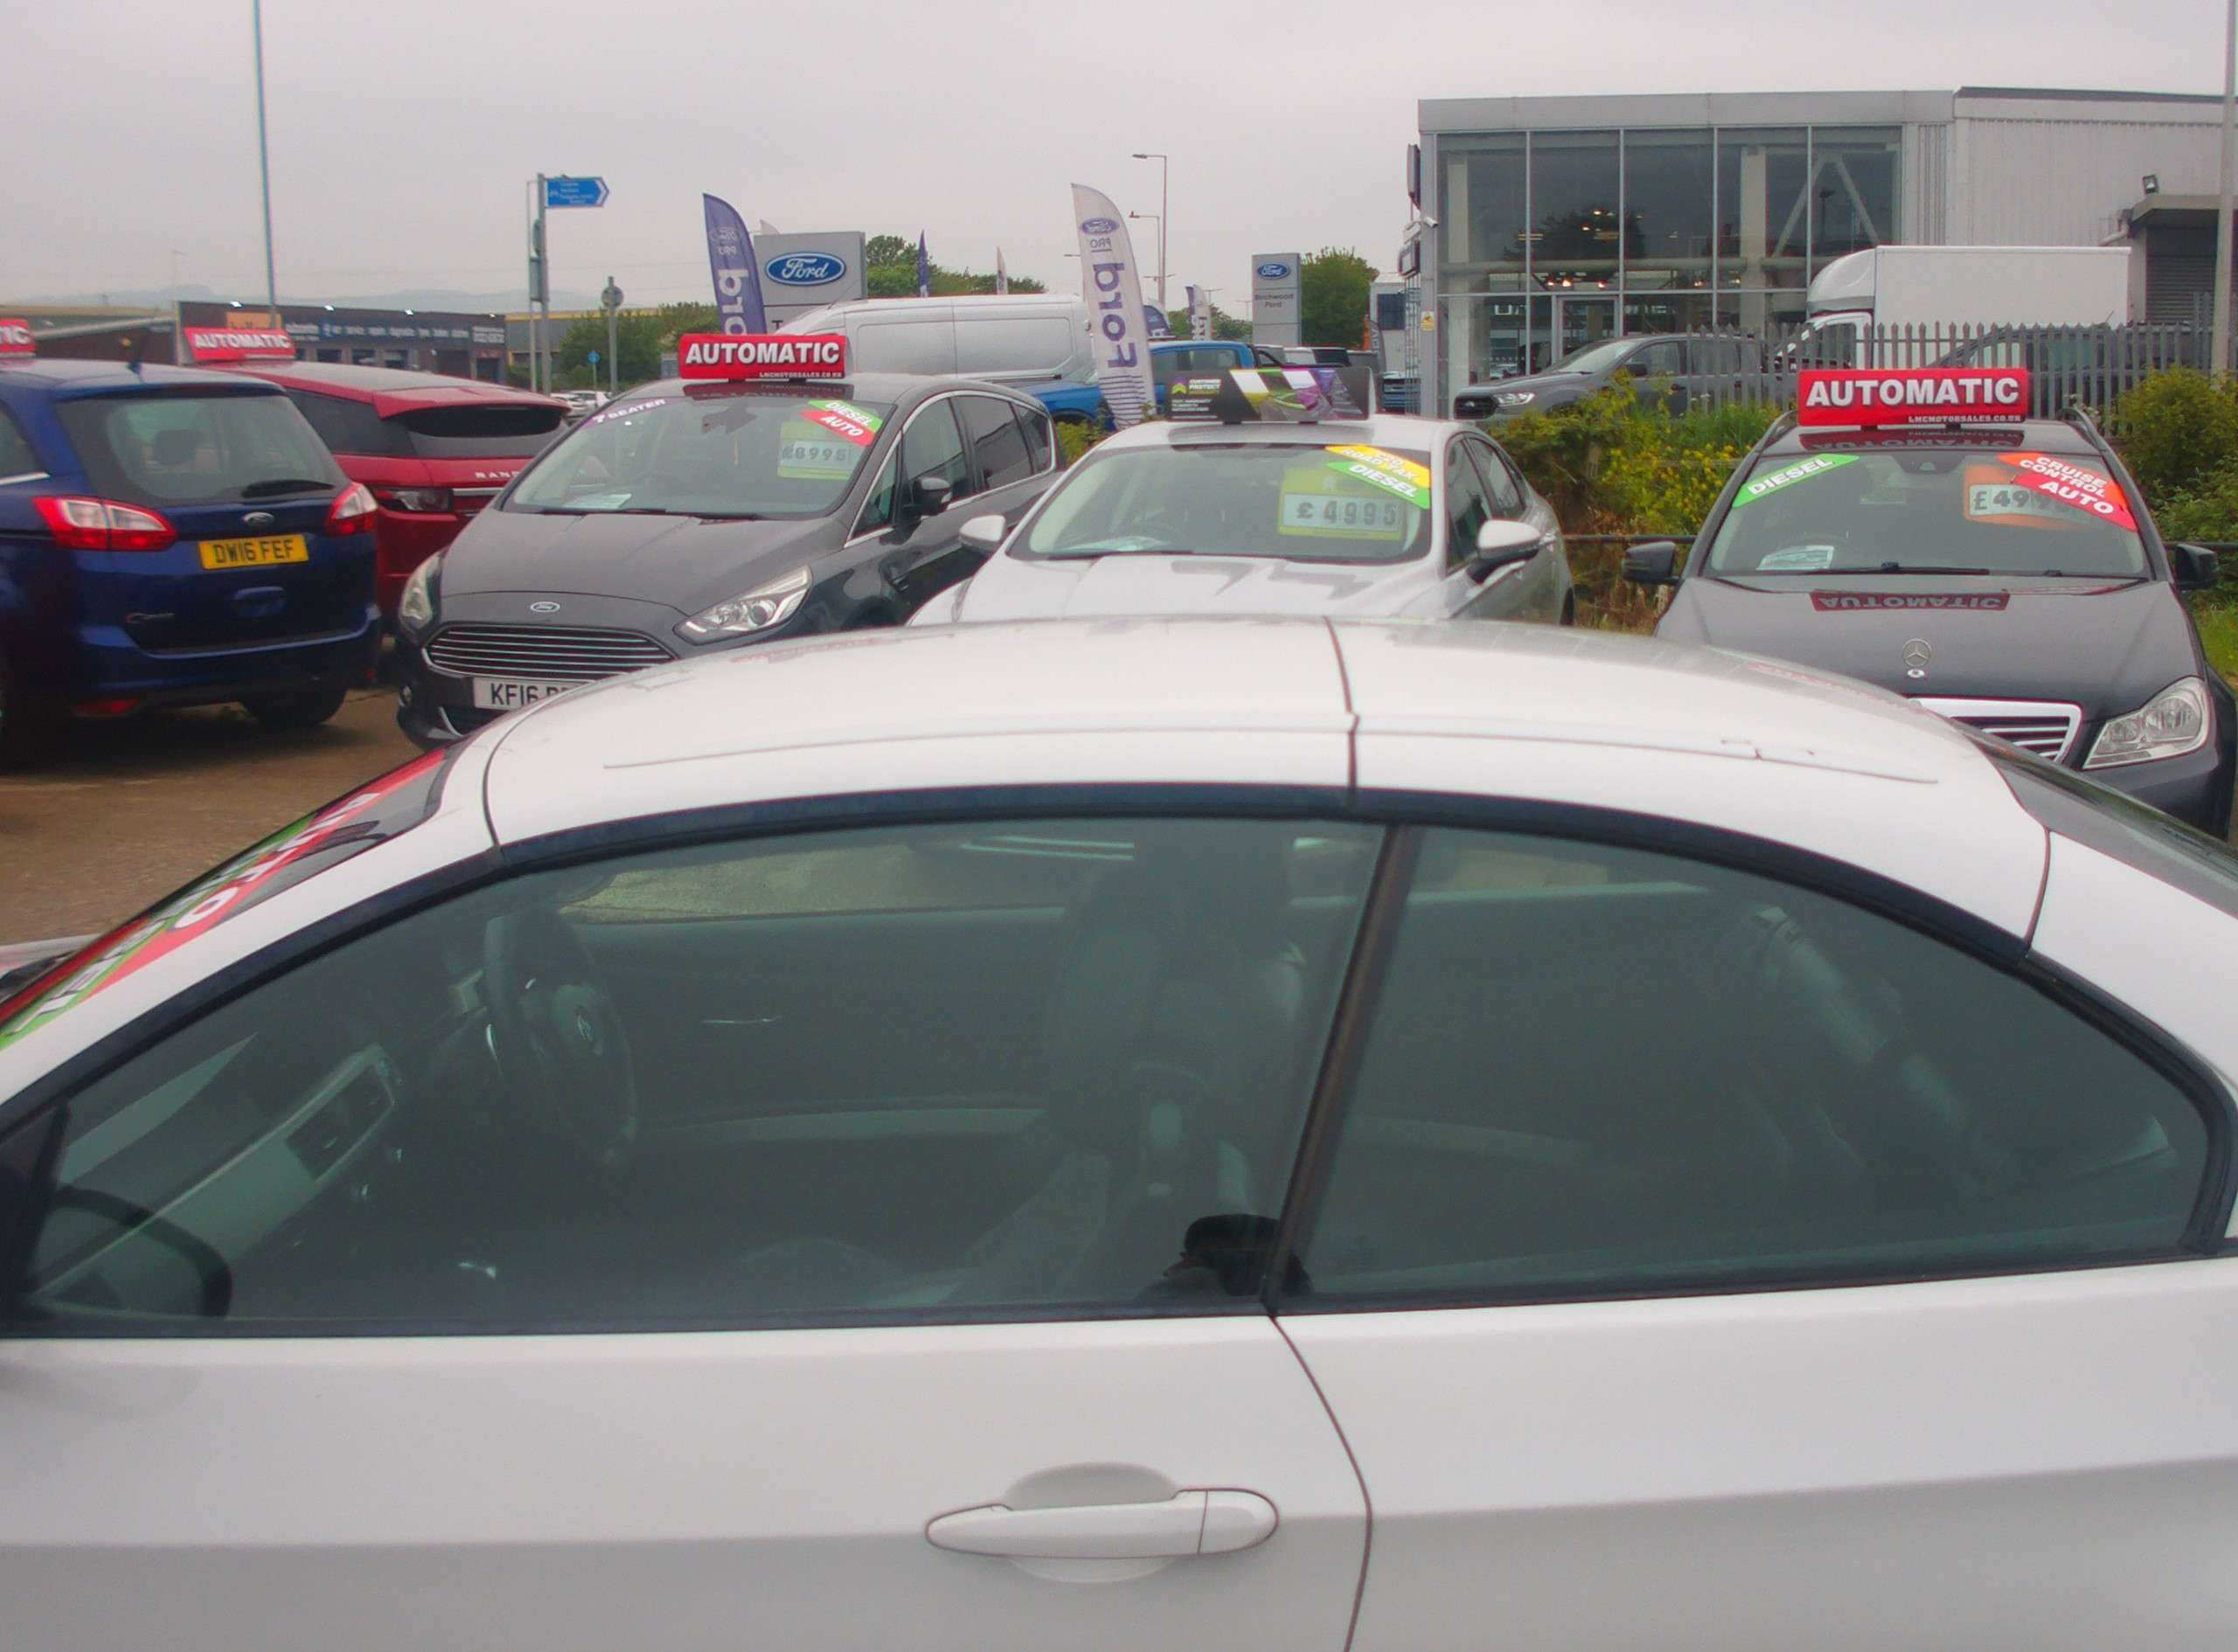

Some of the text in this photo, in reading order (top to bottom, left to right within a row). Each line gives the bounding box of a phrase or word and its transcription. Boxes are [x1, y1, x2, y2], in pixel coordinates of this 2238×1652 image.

[194, 333, 293, 350] AUTOMATIC
[685, 341, 841, 364] AUTOMATIC
[1805, 377, 2019, 407] AUTOMATIC
[608, 399, 665, 419] SEATER
[824, 400, 873, 427] DIESEL
[1908, 414, 2022, 424] LMCMOTORSALES.CO.UK
[822, 414, 865, 437] AUTO
[1348, 463, 1418, 497] DIESEL
[1748, 458, 1834, 496] DIESEL
[2019, 459, 2106, 498] CONTROL
[2035, 456, 2108, 489] CRUISE
[2039, 481, 2115, 515] AUTO
[1296, 500, 1398, 525] £4995
[212, 538, 295, 564] DW16 FEF
[490, 683, 539, 706] KF16
